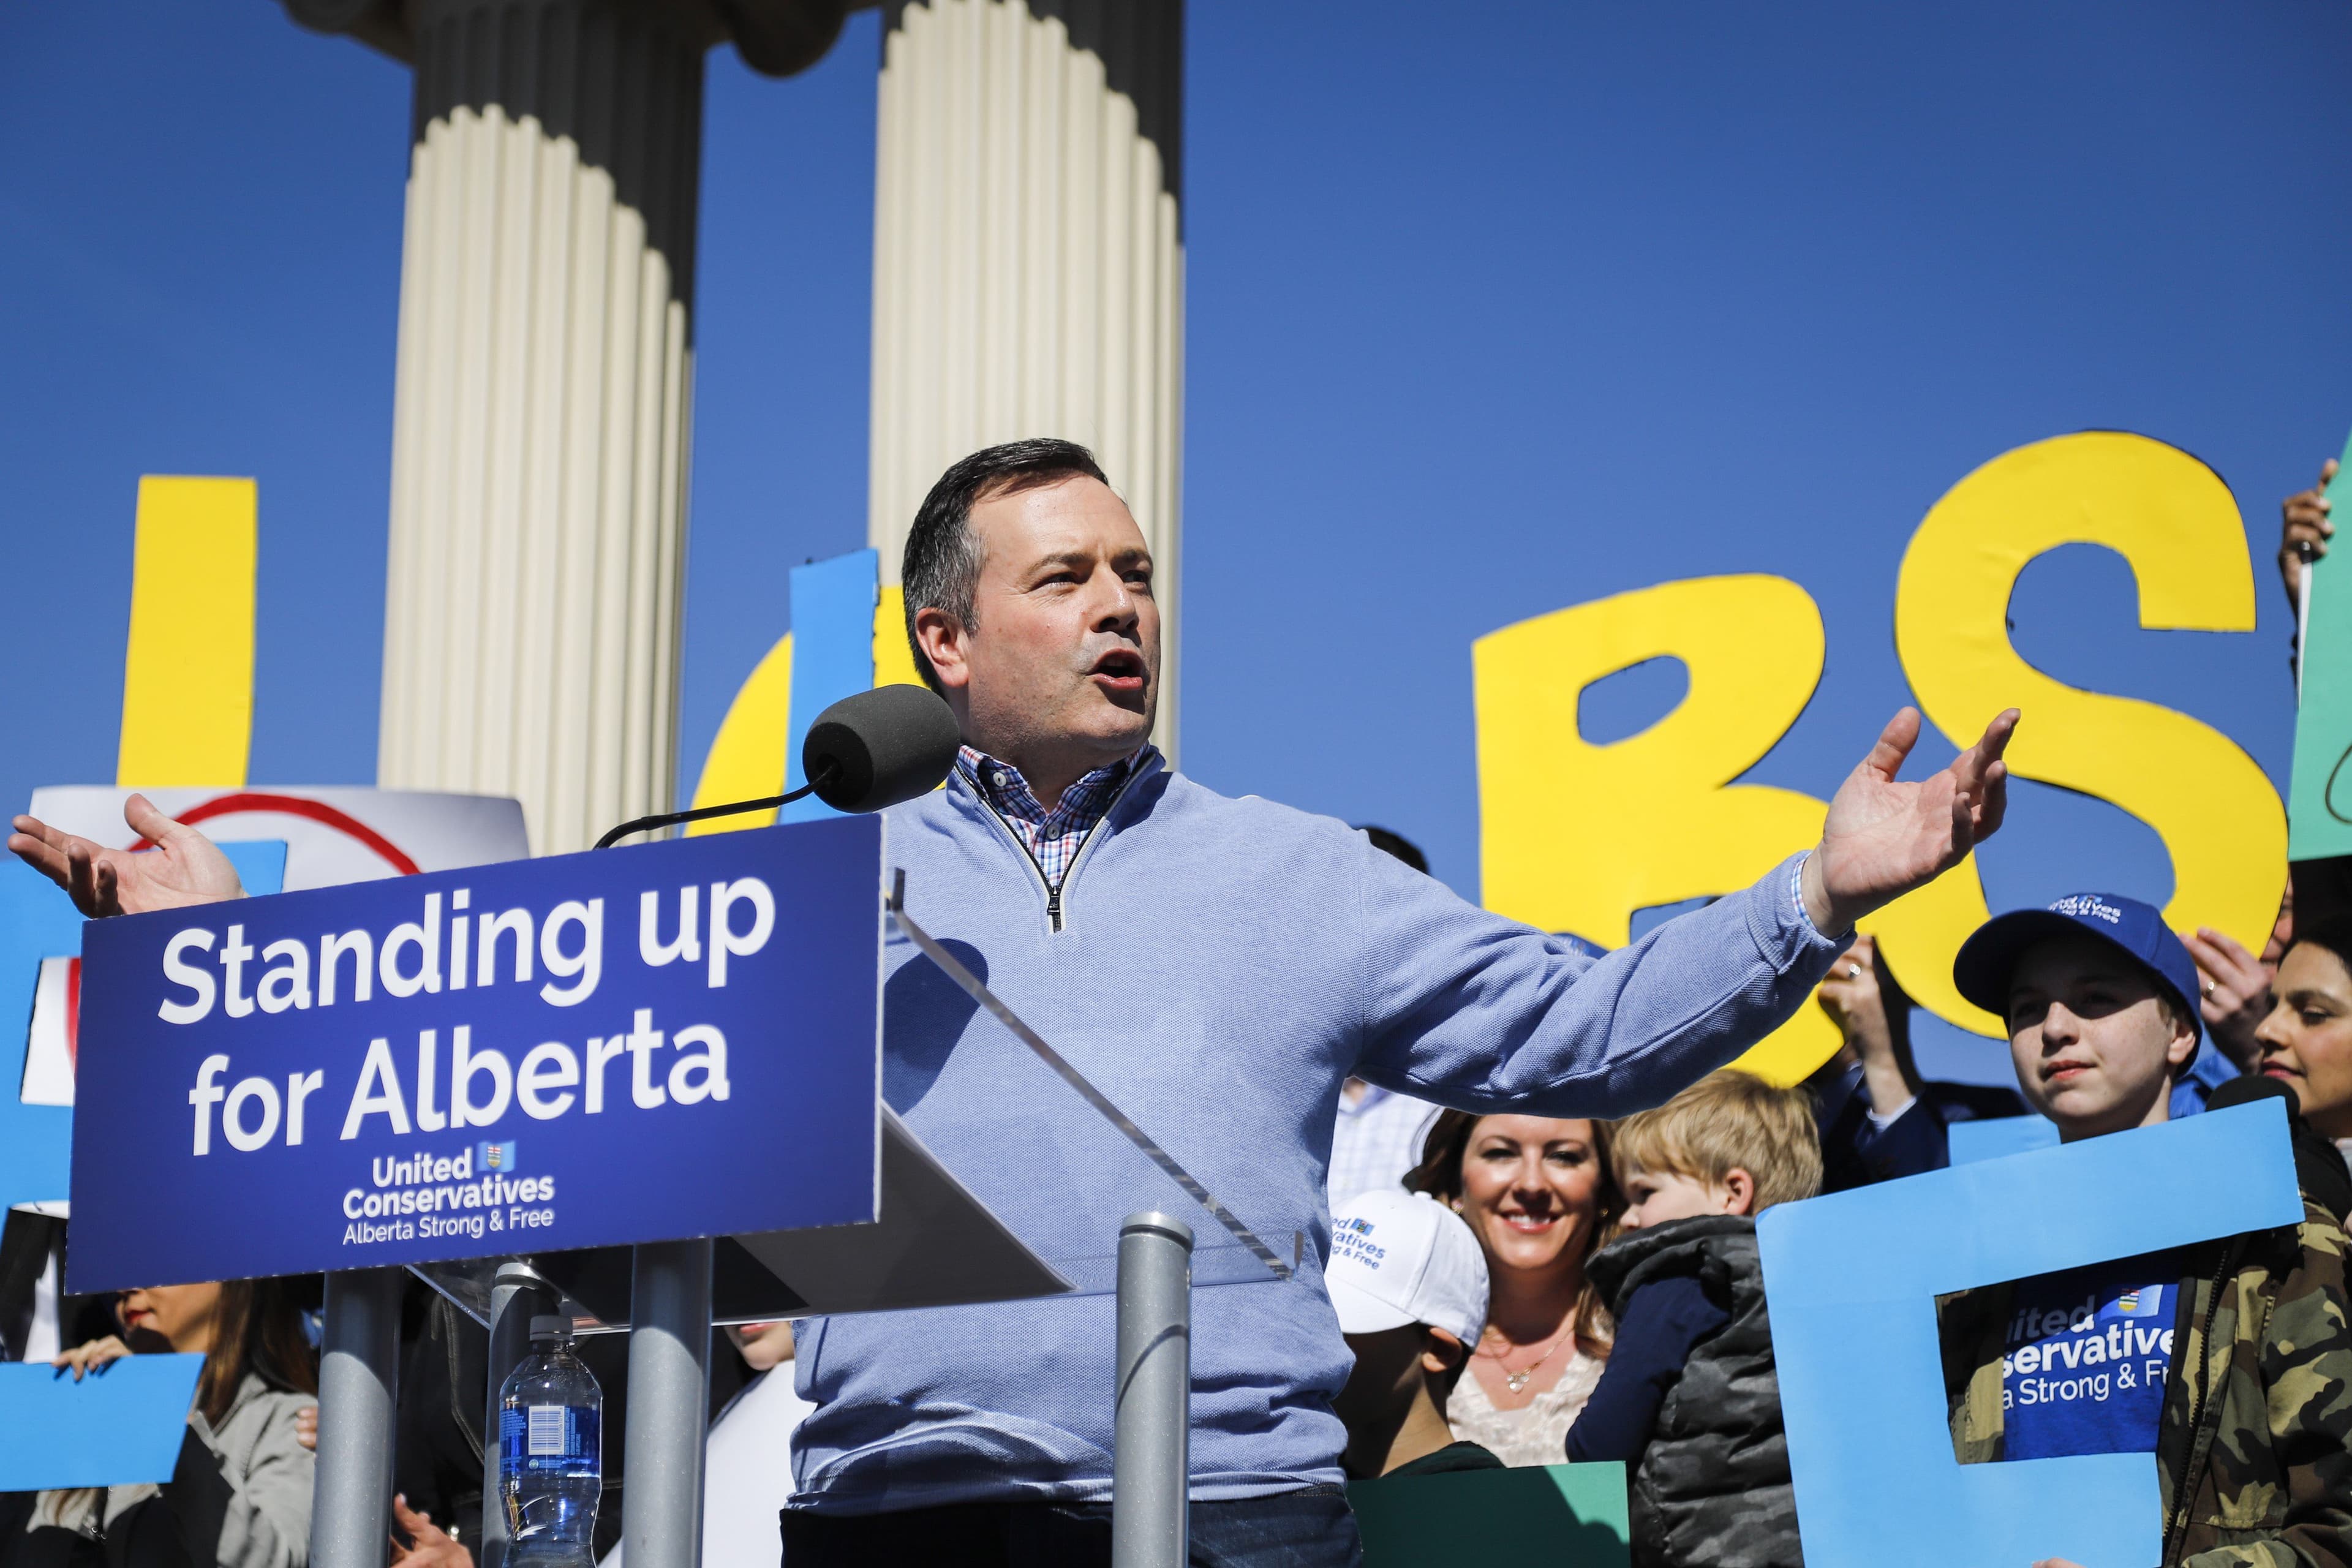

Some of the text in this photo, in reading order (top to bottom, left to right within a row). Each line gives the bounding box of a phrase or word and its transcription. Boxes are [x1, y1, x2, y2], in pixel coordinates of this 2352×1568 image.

[157, 876, 775, 1025] Standing up
[189, 1008, 730, 1156] for Alberta
[372, 1147, 472, 1188] United
[342, 1173, 555, 1219] Conservatives
[342, 1206, 555, 1245] Alberta Strong & Free
[1353, 1251, 1380, 1270] Free
[2019, 1371, 2110, 1405] Strong
[2117, 1362, 2137, 1390] &
